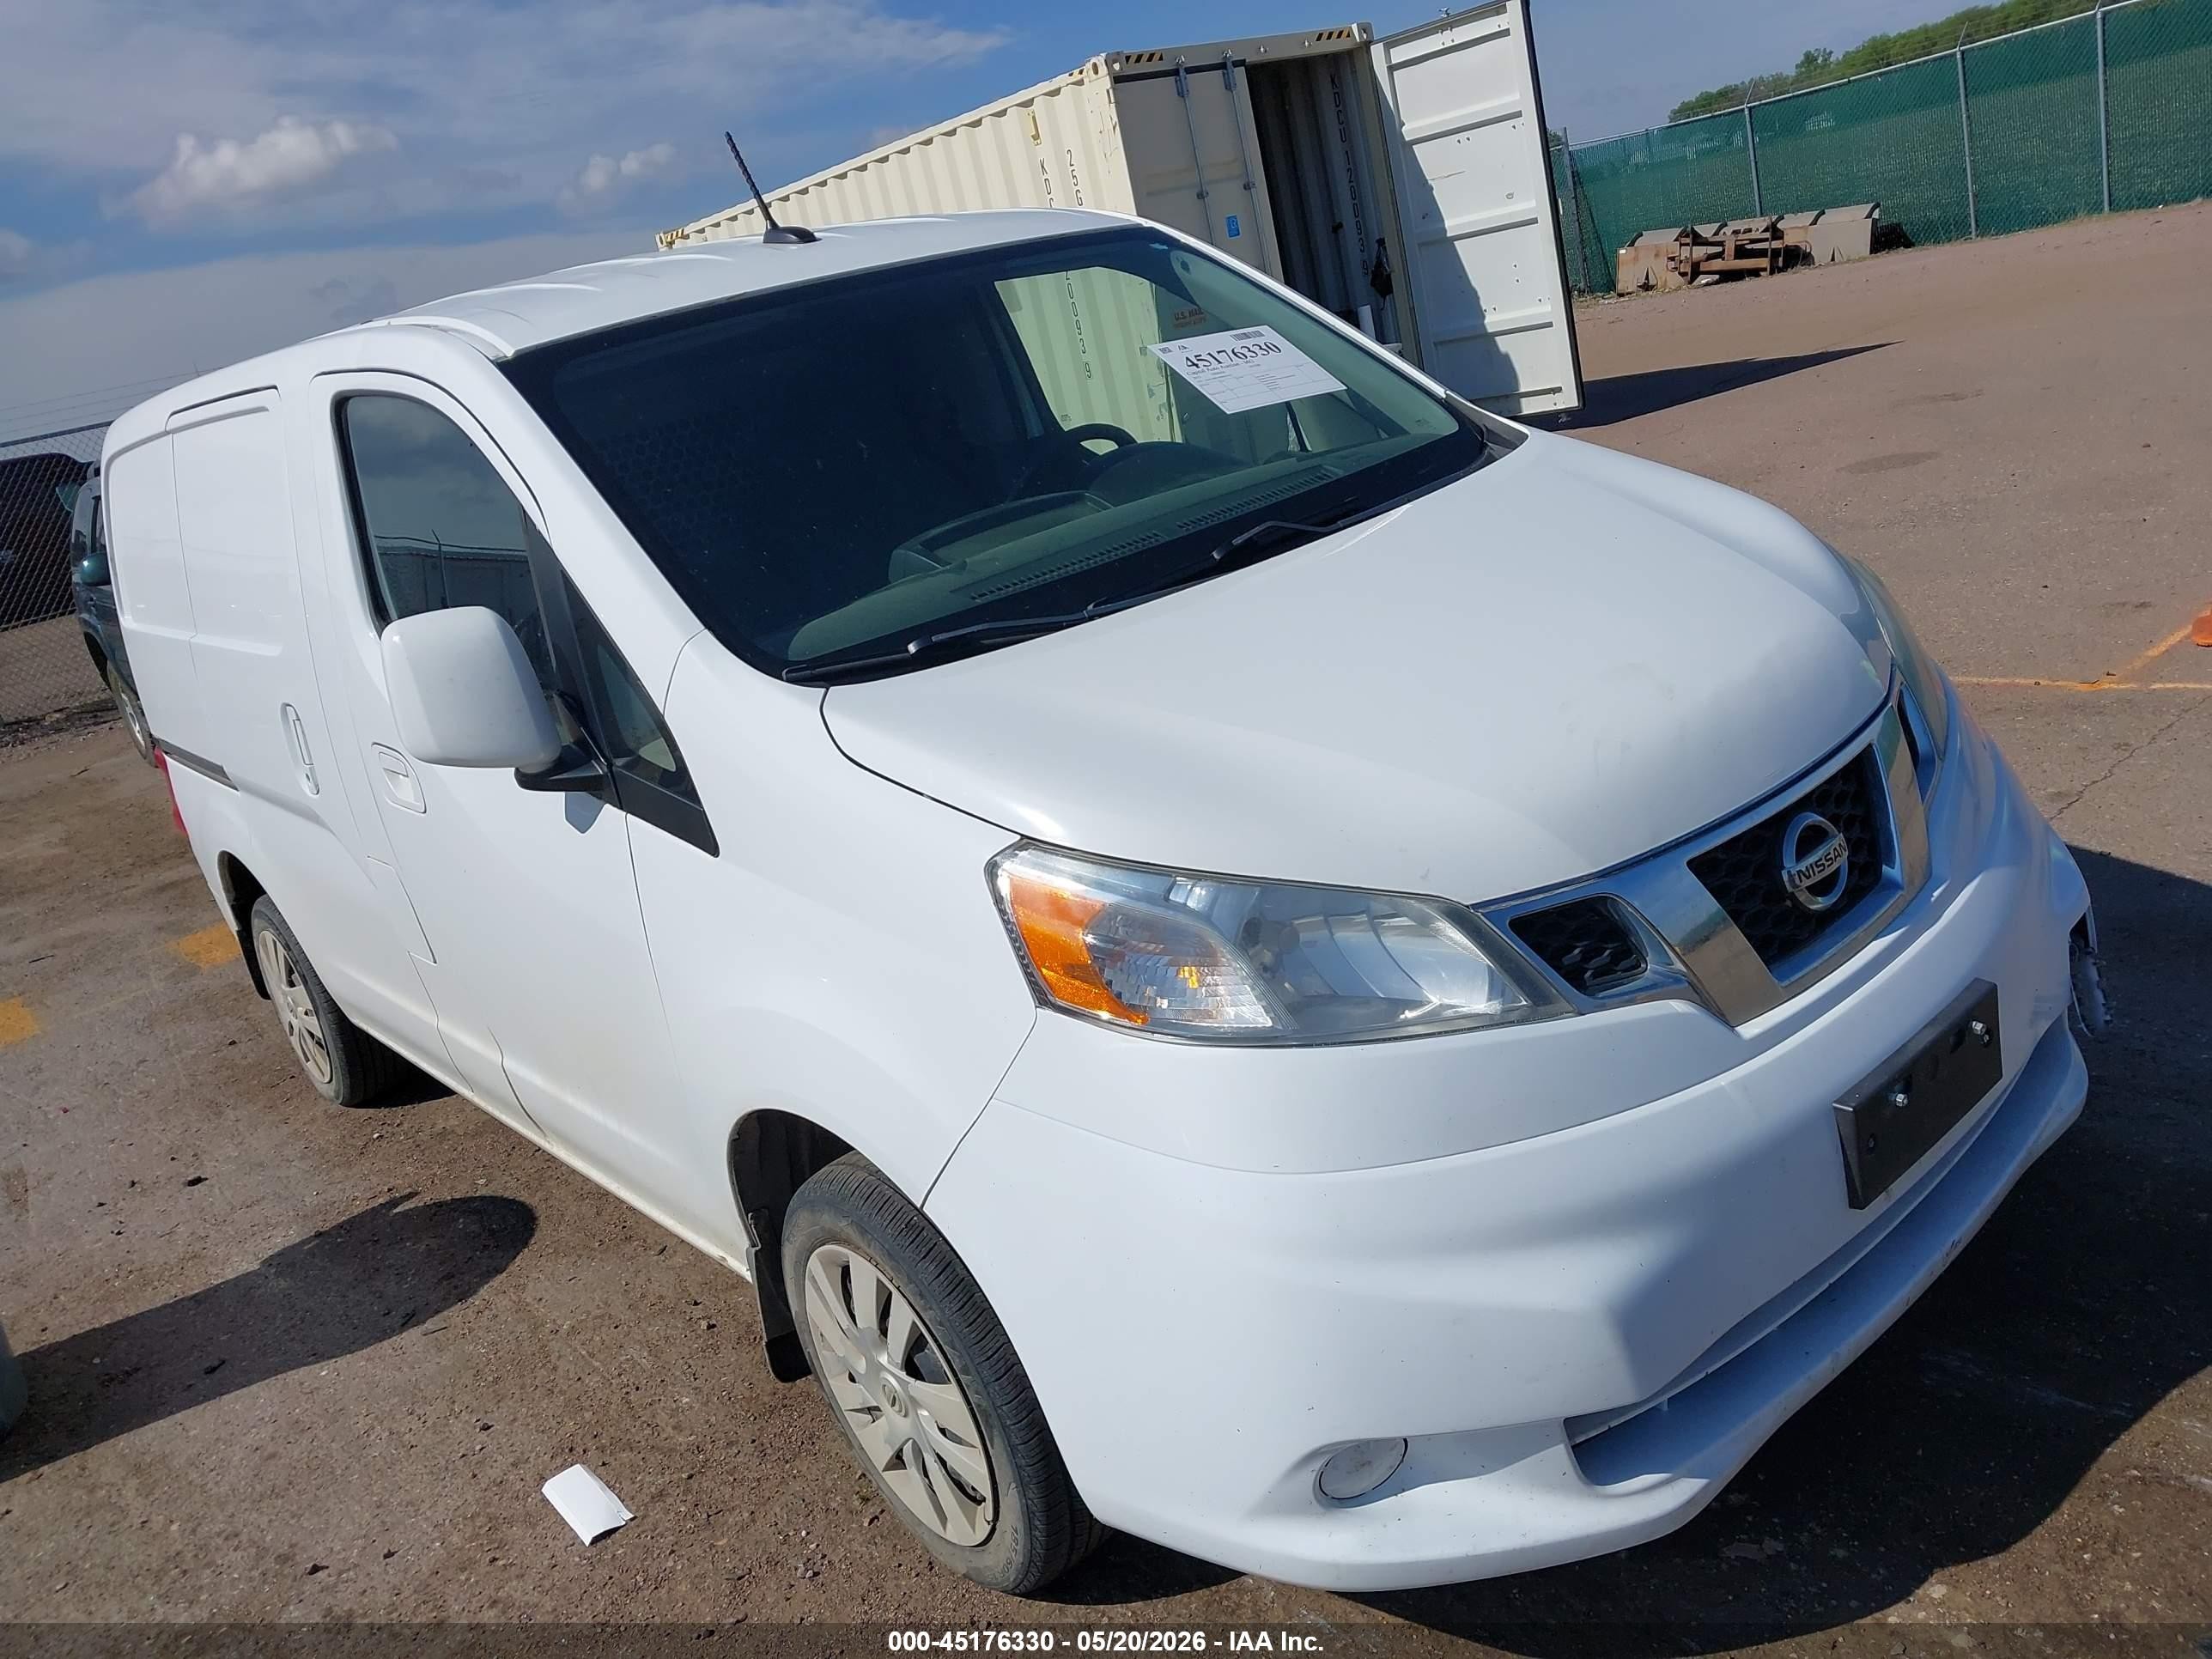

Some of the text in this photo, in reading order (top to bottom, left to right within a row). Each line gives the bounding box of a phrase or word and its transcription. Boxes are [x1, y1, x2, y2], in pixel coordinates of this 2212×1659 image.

[1345, 150, 1365, 253] 120093
[1184, 341, 1283, 369] 45176330
[1796, 839, 1847, 884] NISSAN
